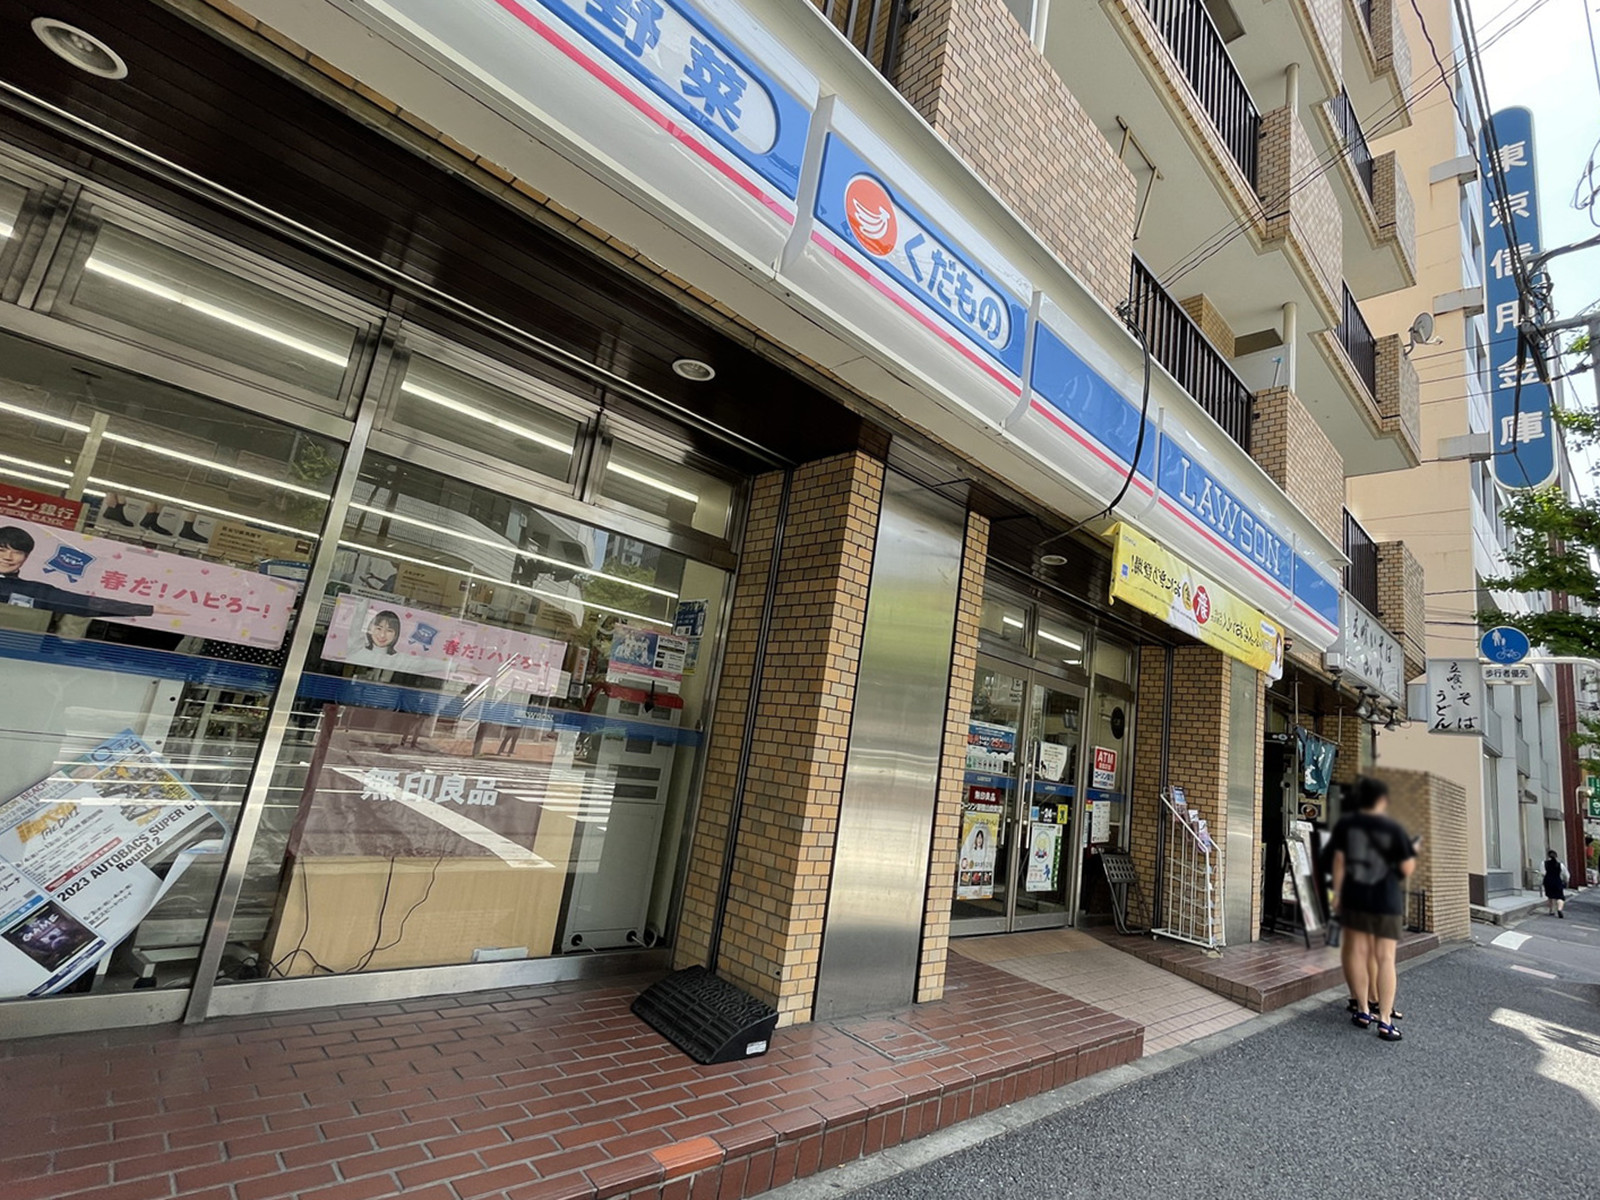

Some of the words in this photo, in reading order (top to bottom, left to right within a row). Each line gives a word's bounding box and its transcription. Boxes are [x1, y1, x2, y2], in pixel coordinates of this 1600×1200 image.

[583, 0, 748, 132] 野菜
[902, 232, 1003, 341] くだもの
[1486, 140, 1546, 446] 東京信用金庫
[1180, 456, 1284, 576] LAWSON
[1485, 668, 1529, 679] 歩行者優先
[1434, 689, 1454, 729] うどん
[1456, 691, 1478, 729] そば
[1097, 750, 1114, 765] ATM
[20, 781, 50, 801] BEACH
[360, 767, 500, 807] 無印良品
[57, 877, 92, 903] 2023
[90, 833, 151, 880] AUTOBACS
[149, 807, 186, 837] SUPER
[115, 844, 152, 873] Round
[151, 836, 164, 850] 2
